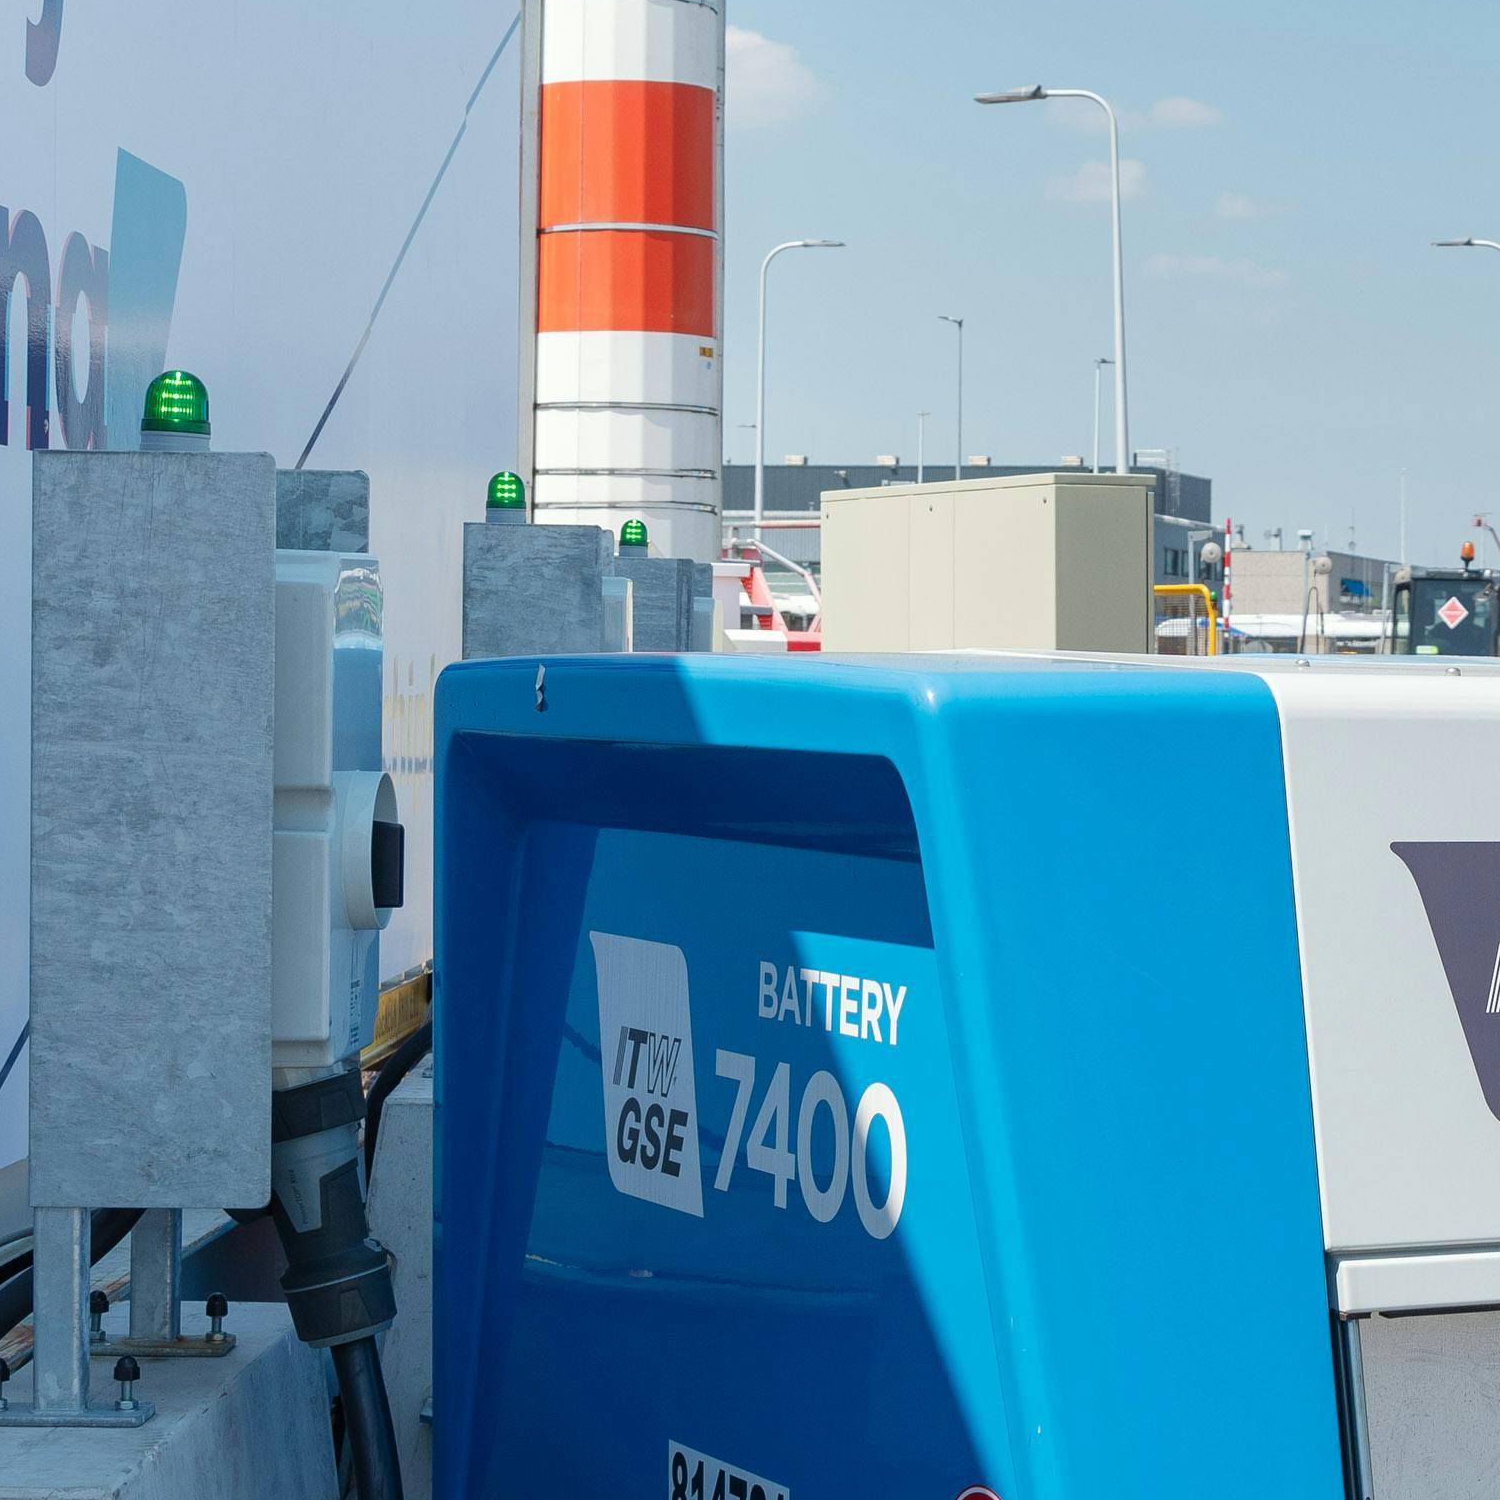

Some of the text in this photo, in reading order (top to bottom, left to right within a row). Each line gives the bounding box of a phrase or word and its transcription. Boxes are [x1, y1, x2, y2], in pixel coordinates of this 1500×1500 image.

[758, 960, 908, 1046] BATTERY
[612, 1026, 682, 1098] ITW
[617, 1097, 688, 1178] GSE
[714, 1048, 907, 1240] 7400
